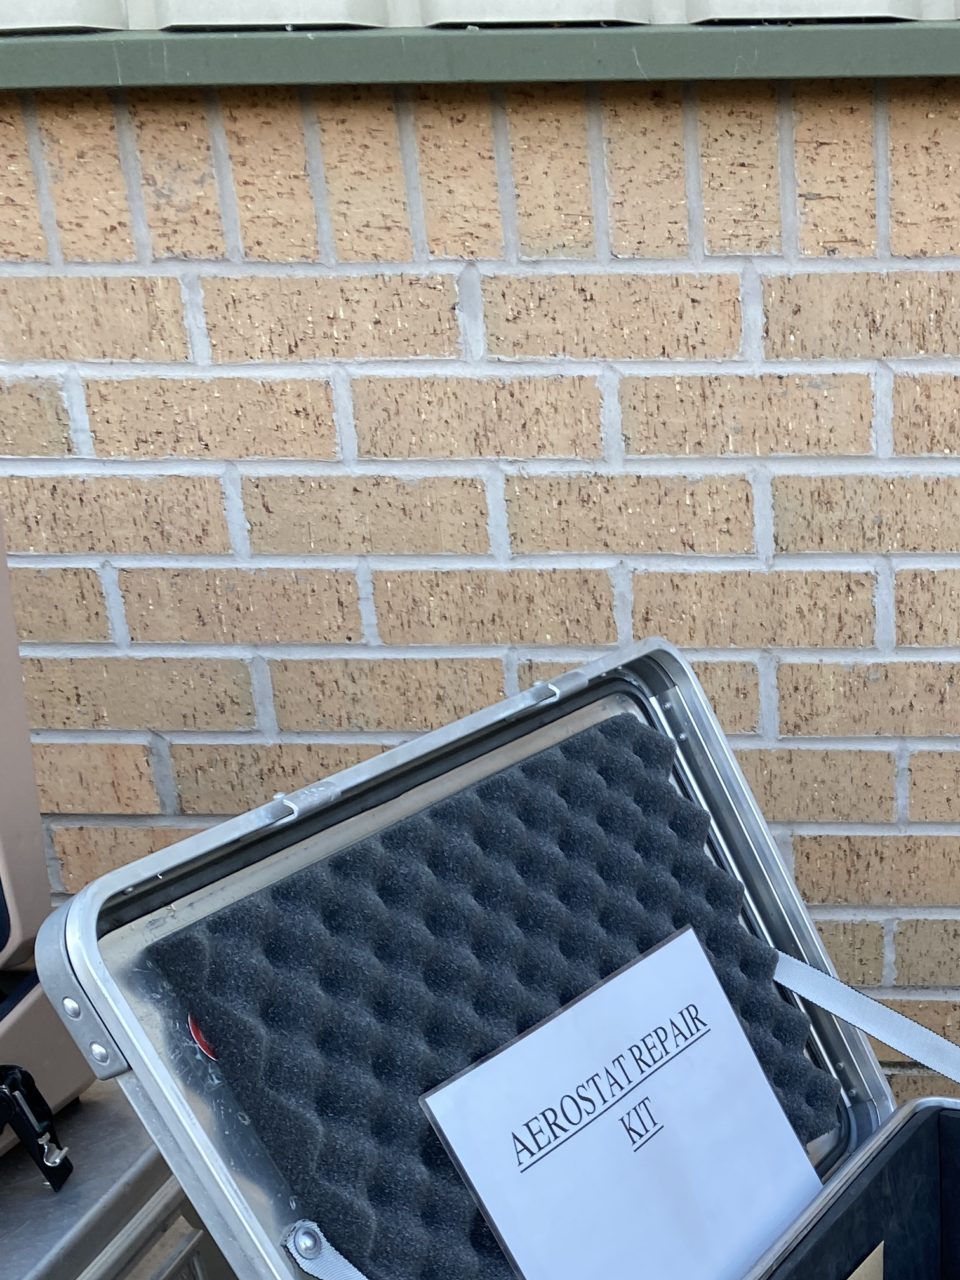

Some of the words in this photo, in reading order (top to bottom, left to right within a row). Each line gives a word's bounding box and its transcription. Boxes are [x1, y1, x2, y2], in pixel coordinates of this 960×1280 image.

[511, 1054, 633, 1167] AEROSTAT
[628, 1004, 708, 1075] REPAIR
[618, 1096, 659, 1146] KIT
